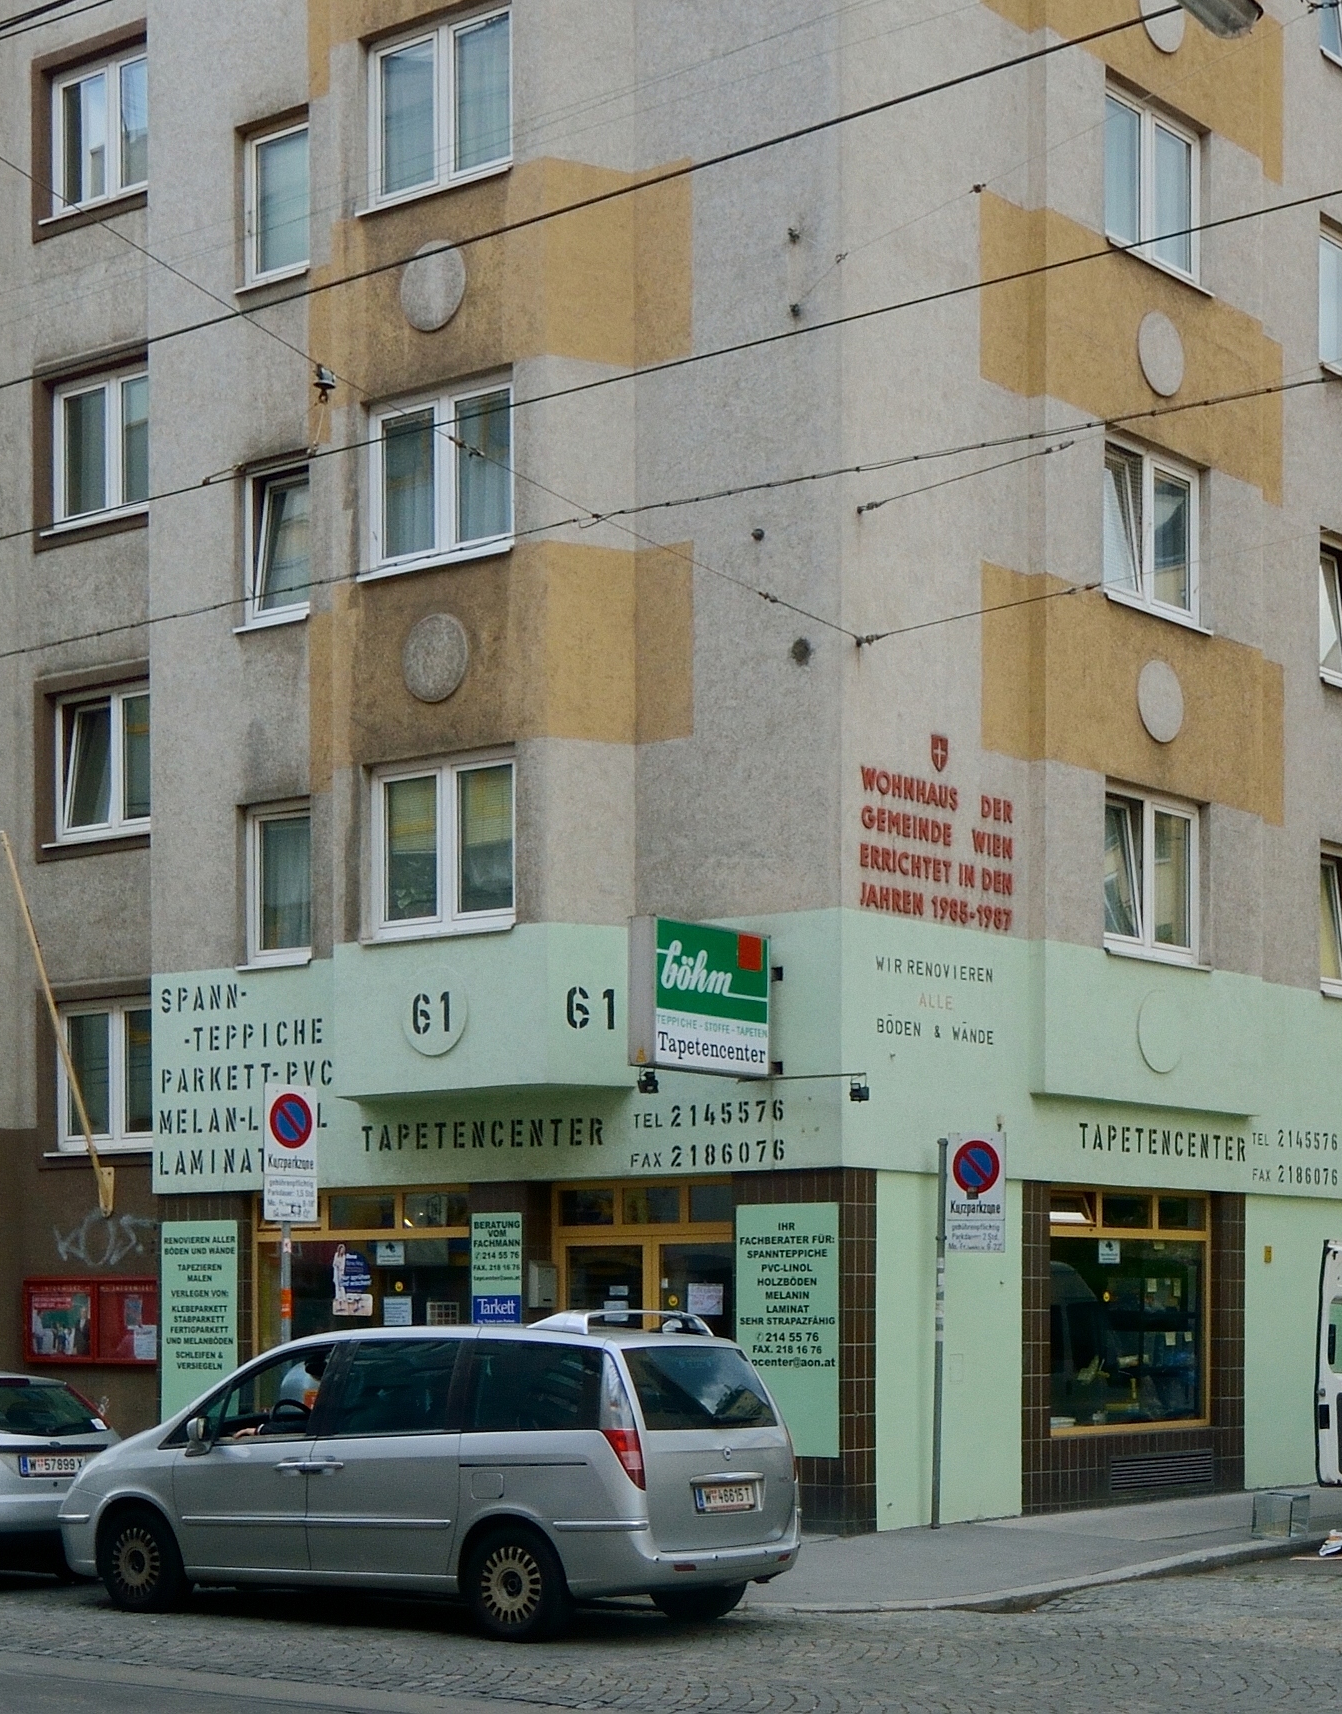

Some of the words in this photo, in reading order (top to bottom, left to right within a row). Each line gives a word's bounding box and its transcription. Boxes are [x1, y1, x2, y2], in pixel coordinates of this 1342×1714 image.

[861, 766, 958, 811] WOHNHAUS
[981, 795, 1013, 823] DER
[861, 805, 952, 846] GEMEINDE
[972, 829, 1013, 860] WIEN
[860, 843, 952, 884] ERRICHTET
[959, 863, 975, 888] IN
[982, 868, 1013, 896] DEN
[860, 882, 924, 916] JAHREN
[931, 895, 1013, 931] 1985-1987
[876, 955, 902, 974] WIR
[907, 959, 994, 983] RENOVIEREN
[161, 984, 247, 1014] SPANN-
[918, 992, 954, 1011] ALLE
[412, 991, 451, 1035] 61
[566, 986, 615, 1030] 61
[656, 1014, 698, 1030] TEPPICHE
[704, 1021, 731, 1035] STOFFE
[736, 1026, 768, 1039] TAPETEN
[934, 1025, 941, 1038] &
[184, 1018, 323, 1051] -TEPPICHE
[658, 1031, 766, 1064] Tapetencenter
[633, 1113, 663, 1129] TEL
[671, 1099, 784, 1128] 2145576
[362, 1117, 604, 1152] TAPETENCENTER
[1252, 1132, 1270, 1147] TEL
[1277, 1129, 1338, 1151] 2145576
[1079, 1123, 1247, 1162] TAPETENCENTER
[630, 1153, 663, 1168] FAX
[671, 1139, 785, 1168] 2186076
[268, 1153, 314, 1171] Kurzparkzone
[1252, 1168, 1271, 1182] FAX
[950, 1200, 1001, 1217] Kurzparkzone
[474, 1221, 520, 1229] BERATUNG
[778, 1222, 795, 1231] IHR
[487, 1229, 507, 1237] VOM
[740, 1236, 809, 1245] FACHBERATER
[812, 1233, 835, 1244] FÜR:
[164, 1236, 210, 1244] RENOVIEREN
[212, 1235, 235, 1243] ALLER
[473, 1239, 520, 1248] FACHMANN
[747, 1249, 828, 1258] SPANNTEPPICHE
[761, 1264, 813, 1272] PVC-LINOL
[187, 1274, 212, 1282] MALEN
[757, 1277, 817, 1286] HOLZBÖDEN
[171, 1290, 209, 1298] VERLEGEN
[211, 1289, 229, 1297] VON:
[765, 1291, 810, 1300] MELANIN
[171, 1305, 227, 1313] KLEBEPARKETT
[477, 1298, 515, 1315] Tarkett
[766, 1305, 809, 1313] LAMINAT
[173, 1315, 225, 1323] STABPARKETT
[740, 1317, 764, 1325] SEHR
[766, 1315, 836, 1325] STRAPAZFÄHIG
[170, 1326, 229, 1334] FERTIGPARKETT
[166, 1337, 181, 1345] UND
[765, 1333, 785, 1342] 214
[789, 1333, 802, 1342] 55
[806, 1332, 819, 1342] 76
[175, 1351, 216, 1359] SCHLEIFEN
[217, 1351, 223, 1359] &
[752, 1345, 773, 1354] FAX.
[776, 1345, 793, 1354] 218
[796, 1346, 807, 1354] 16
[810, 1346, 822, 1354] 76
[176, 1362, 222, 1370] VERSIEGELN
[752, 1357, 836, 1368] pcenter@aon.at
